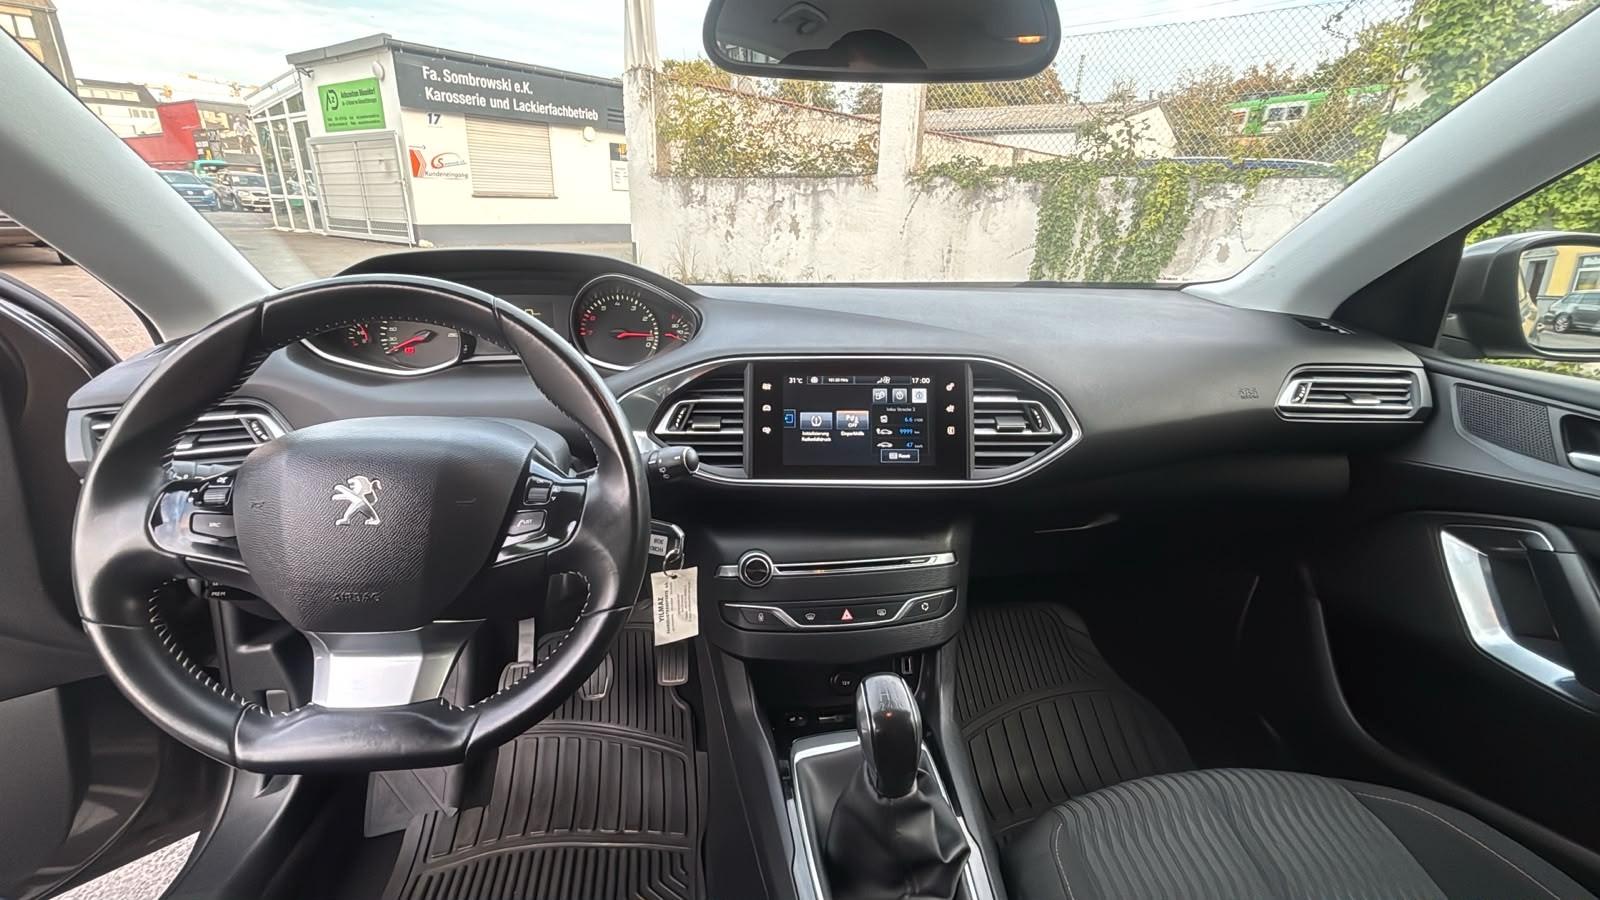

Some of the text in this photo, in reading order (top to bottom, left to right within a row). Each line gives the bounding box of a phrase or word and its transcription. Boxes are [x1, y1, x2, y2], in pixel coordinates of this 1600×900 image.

[422, 65, 533, 95] Fa. Sombrowski e.K.
[424, 86, 598, 121] Karosserie und Lackierfachbetrieb
[427, 112, 440, 125] 17
[333, 591, 381, 603] AIRBAG
[657, 597, 665, 622] YILMAZ
